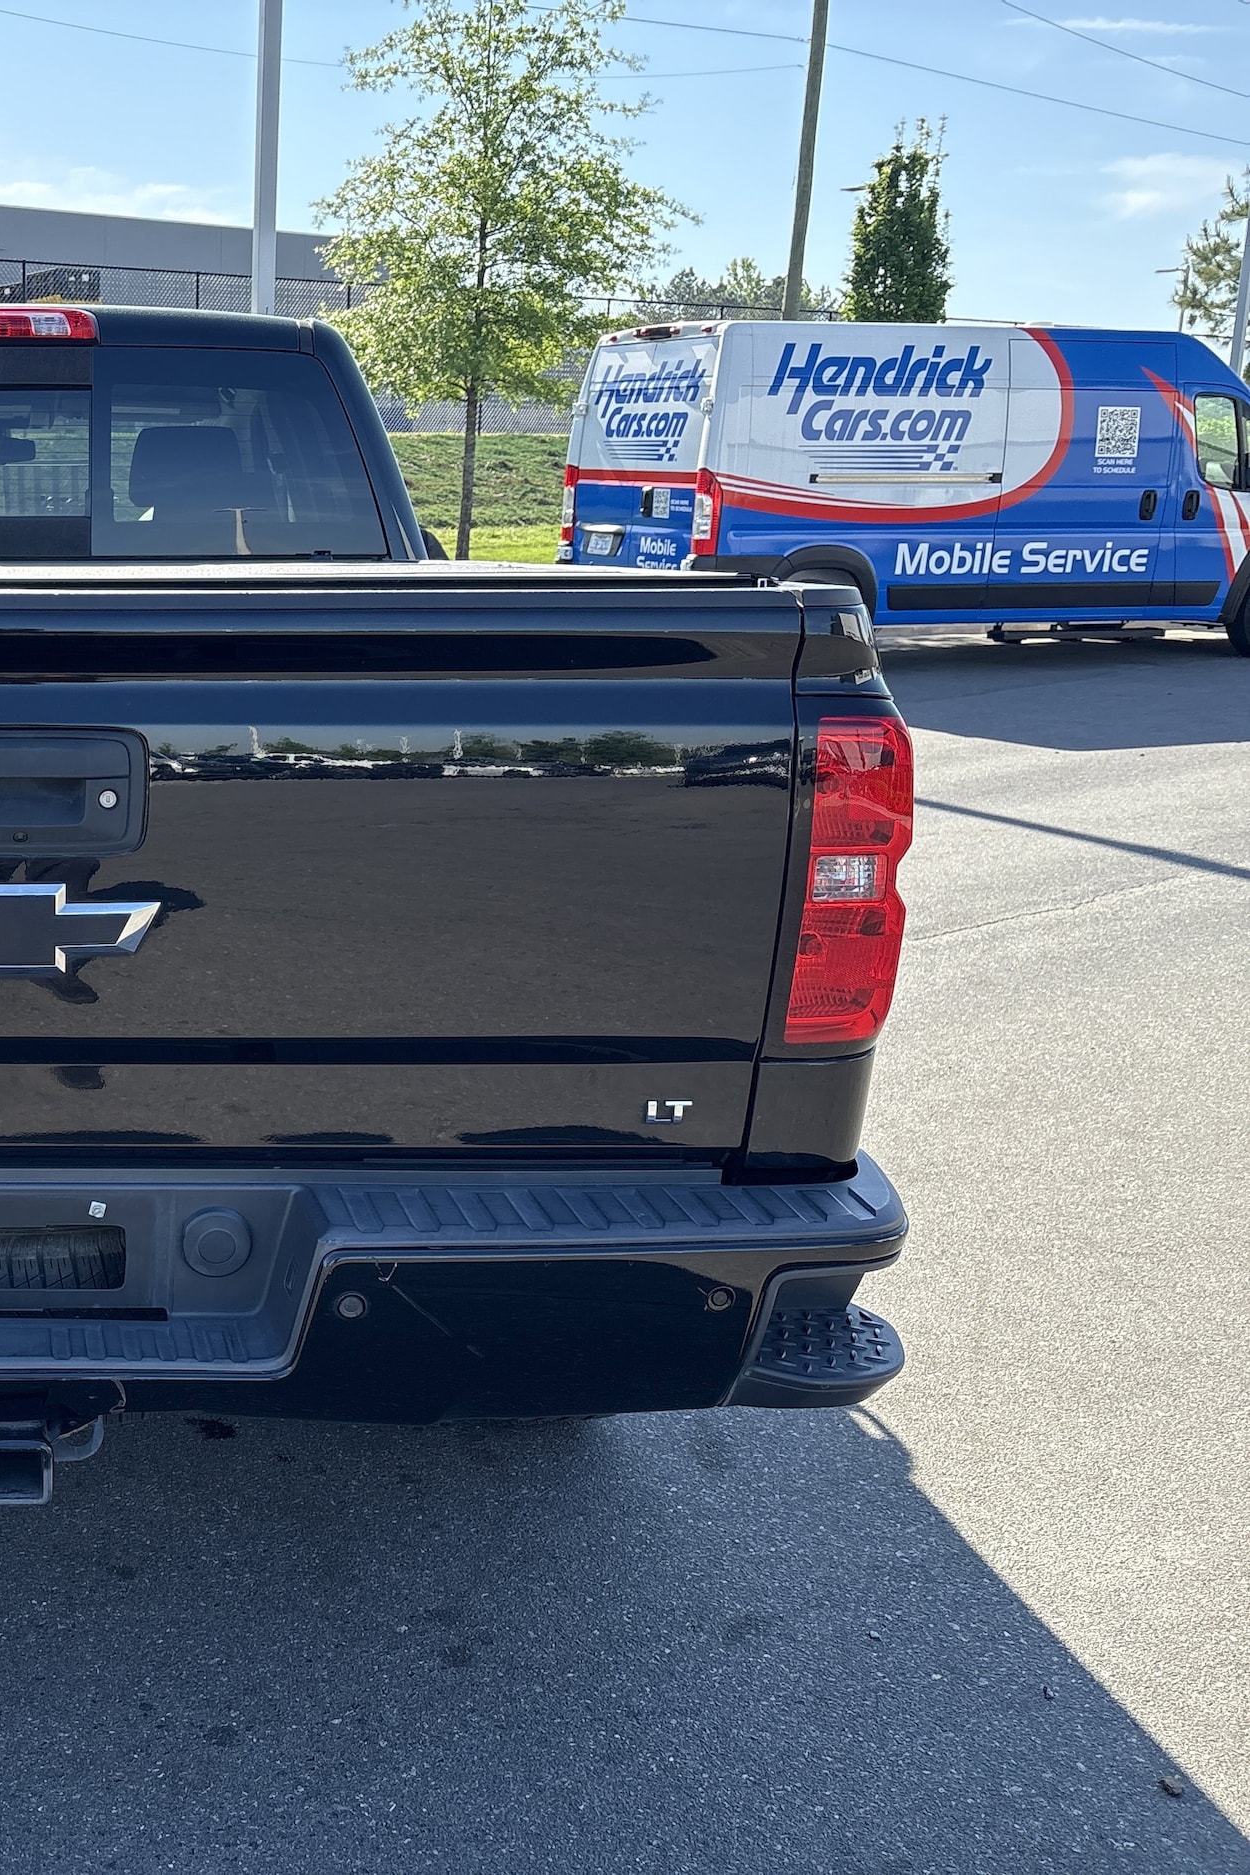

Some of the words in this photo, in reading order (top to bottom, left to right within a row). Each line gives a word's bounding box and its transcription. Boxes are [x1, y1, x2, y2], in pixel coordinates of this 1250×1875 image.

[594, 359, 707, 418] Hendrick
[767, 343, 993, 415] Hendrick
[605, 406, 688, 438] Cars.com
[801, 400, 972, 441] Cars.com
[640, 536, 677, 556] Mobile
[894, 542, 1012, 575] Mobile
[1020, 541, 1149, 574] Service
[646, 1100, 693, 1123] LT
